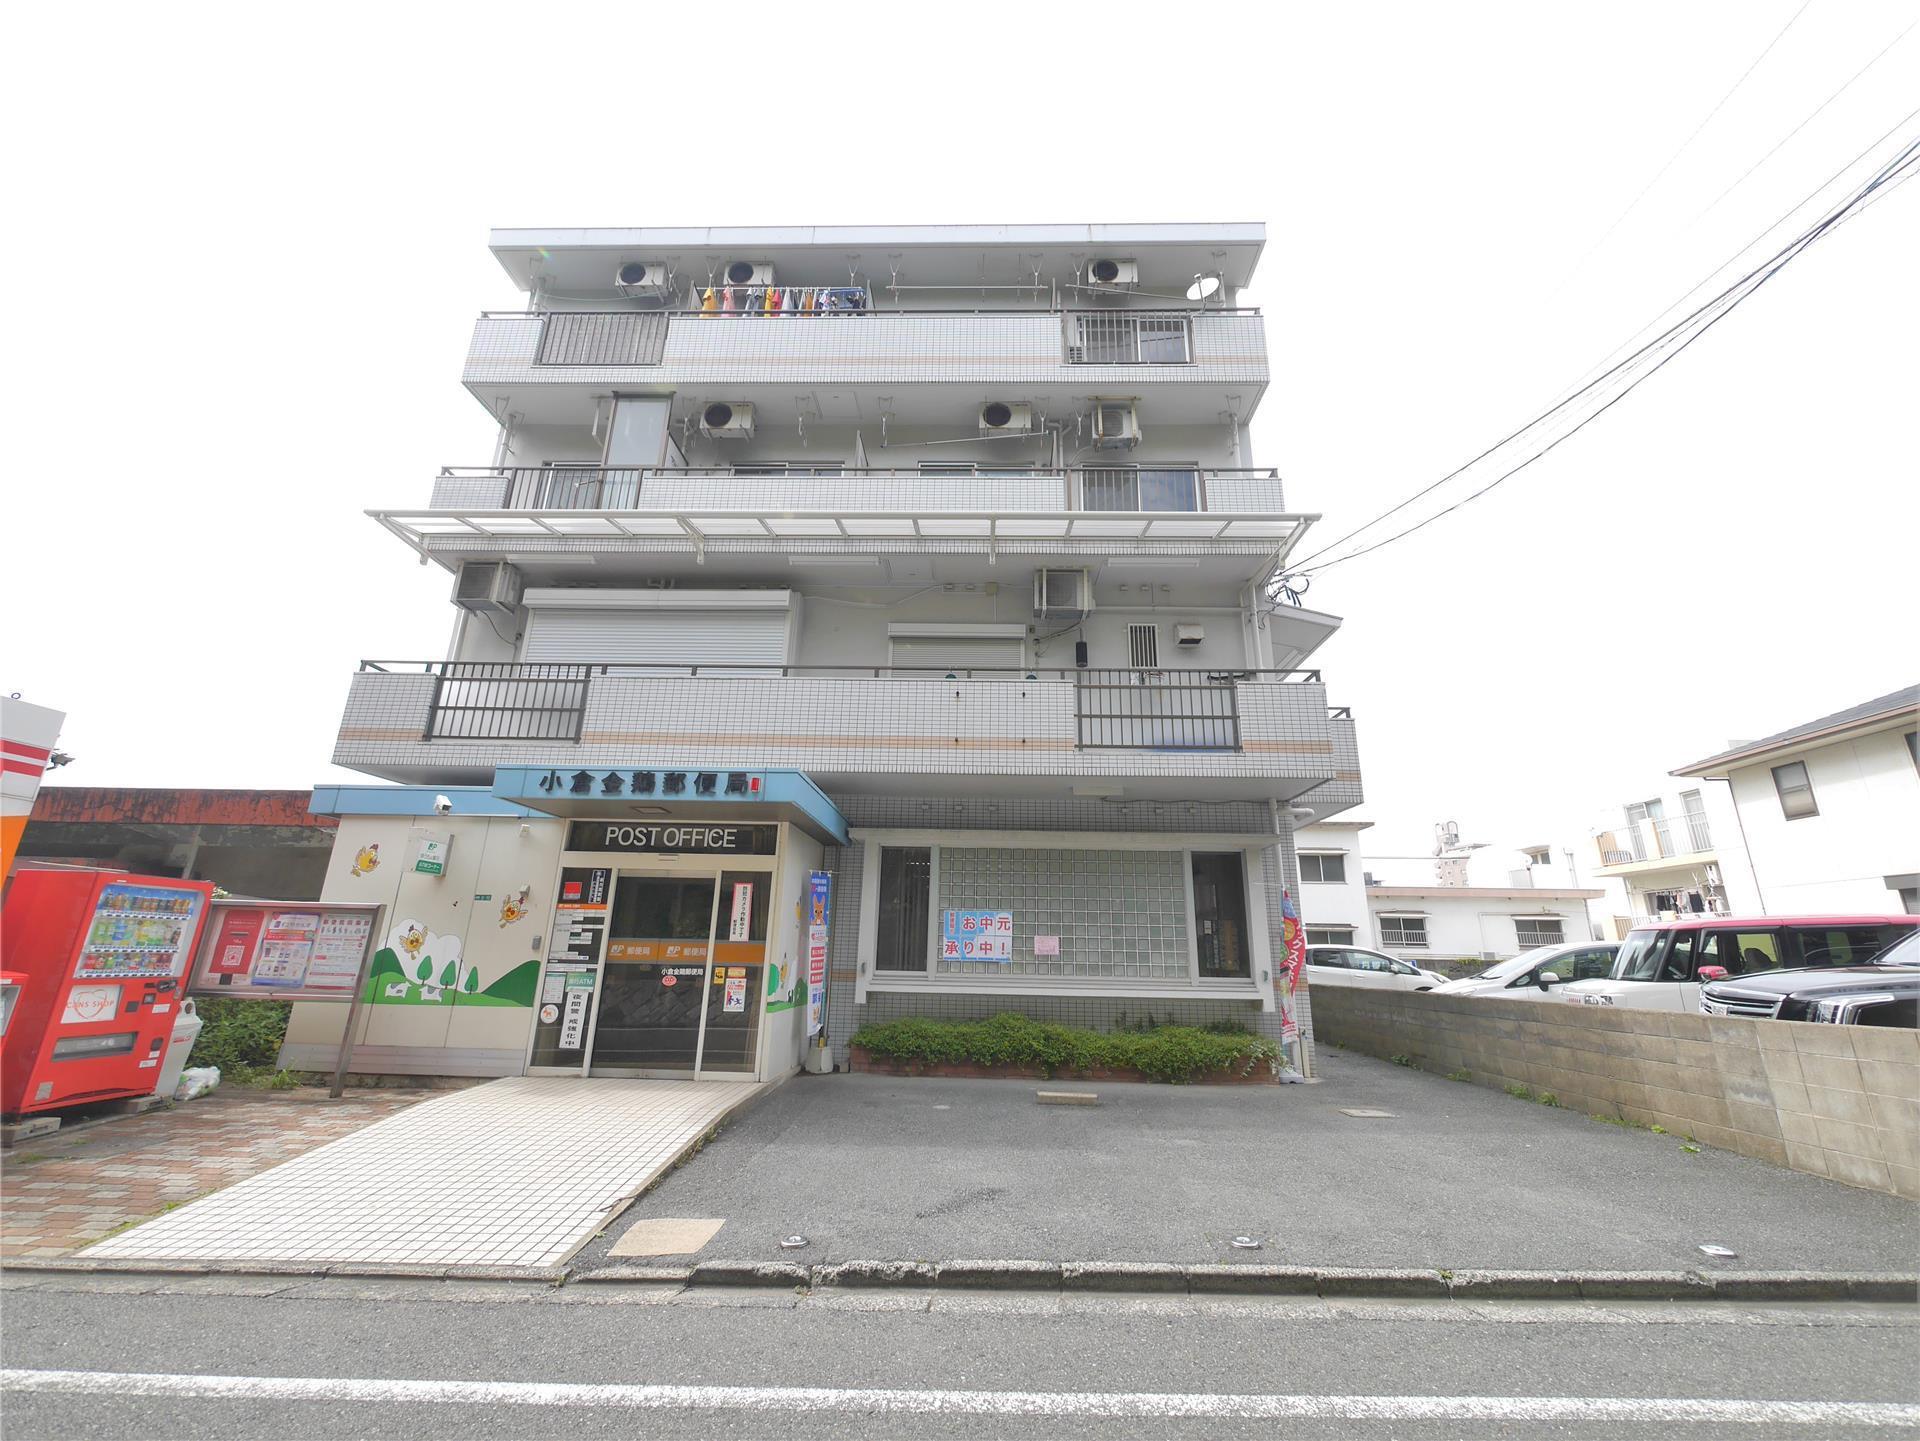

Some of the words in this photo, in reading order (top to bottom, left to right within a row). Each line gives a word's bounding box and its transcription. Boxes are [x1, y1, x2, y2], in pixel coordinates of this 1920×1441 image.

[605, 826, 661, 846] POST
[663, 827, 737, 848] OFFICE
[963, 916, 1010, 931] お中元
